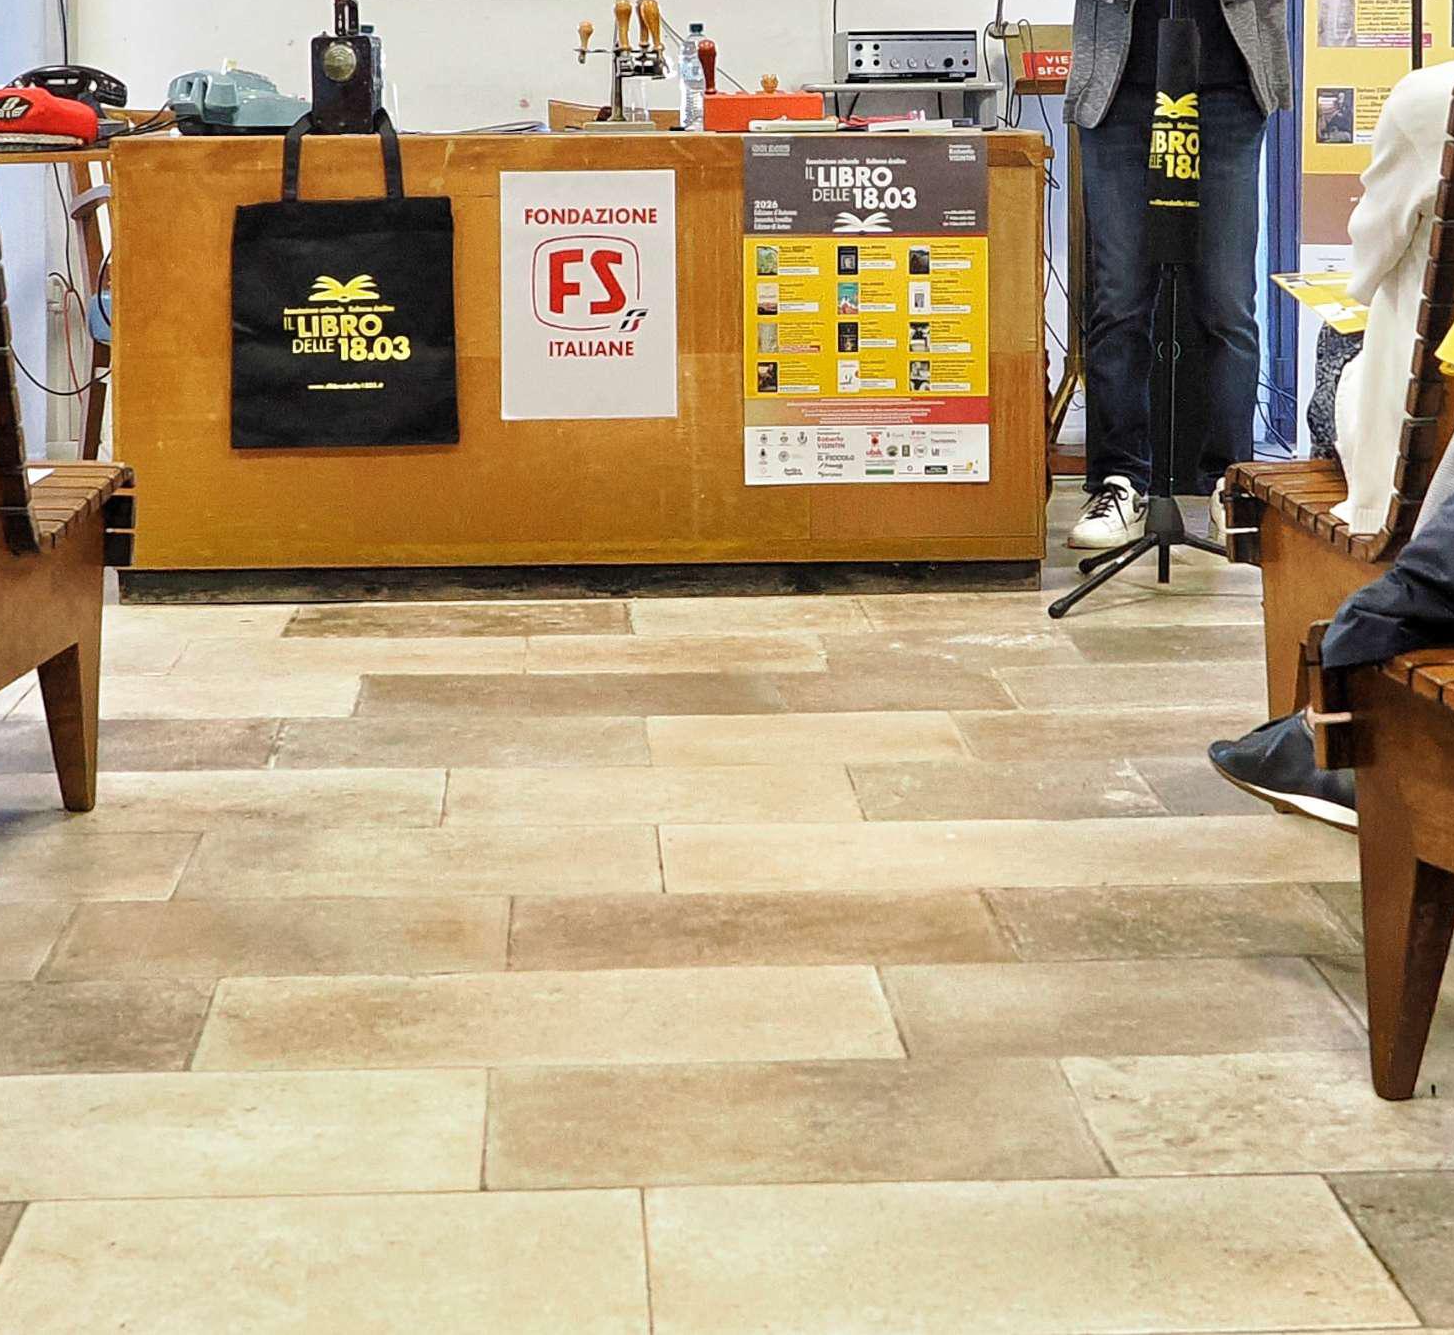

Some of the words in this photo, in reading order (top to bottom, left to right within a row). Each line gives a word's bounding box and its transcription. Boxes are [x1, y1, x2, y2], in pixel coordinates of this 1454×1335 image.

[805, 167, 815, 180] IL
[817, 166, 893, 187] LIBRO
[754, 200, 779, 209] 2026
[812, 188, 850, 202] DELLE
[853, 187, 917, 210] 18.03
[524, 208, 657, 225] FONDAZIONE
[549, 248, 627, 315] FS
[283, 317, 295, 330] IL
[298, 314, 383, 338] LIBRO
[292, 339, 335, 354] DELLE
[338, 335, 411, 361] 18.03
[549, 341, 634, 357] ITALIANE
